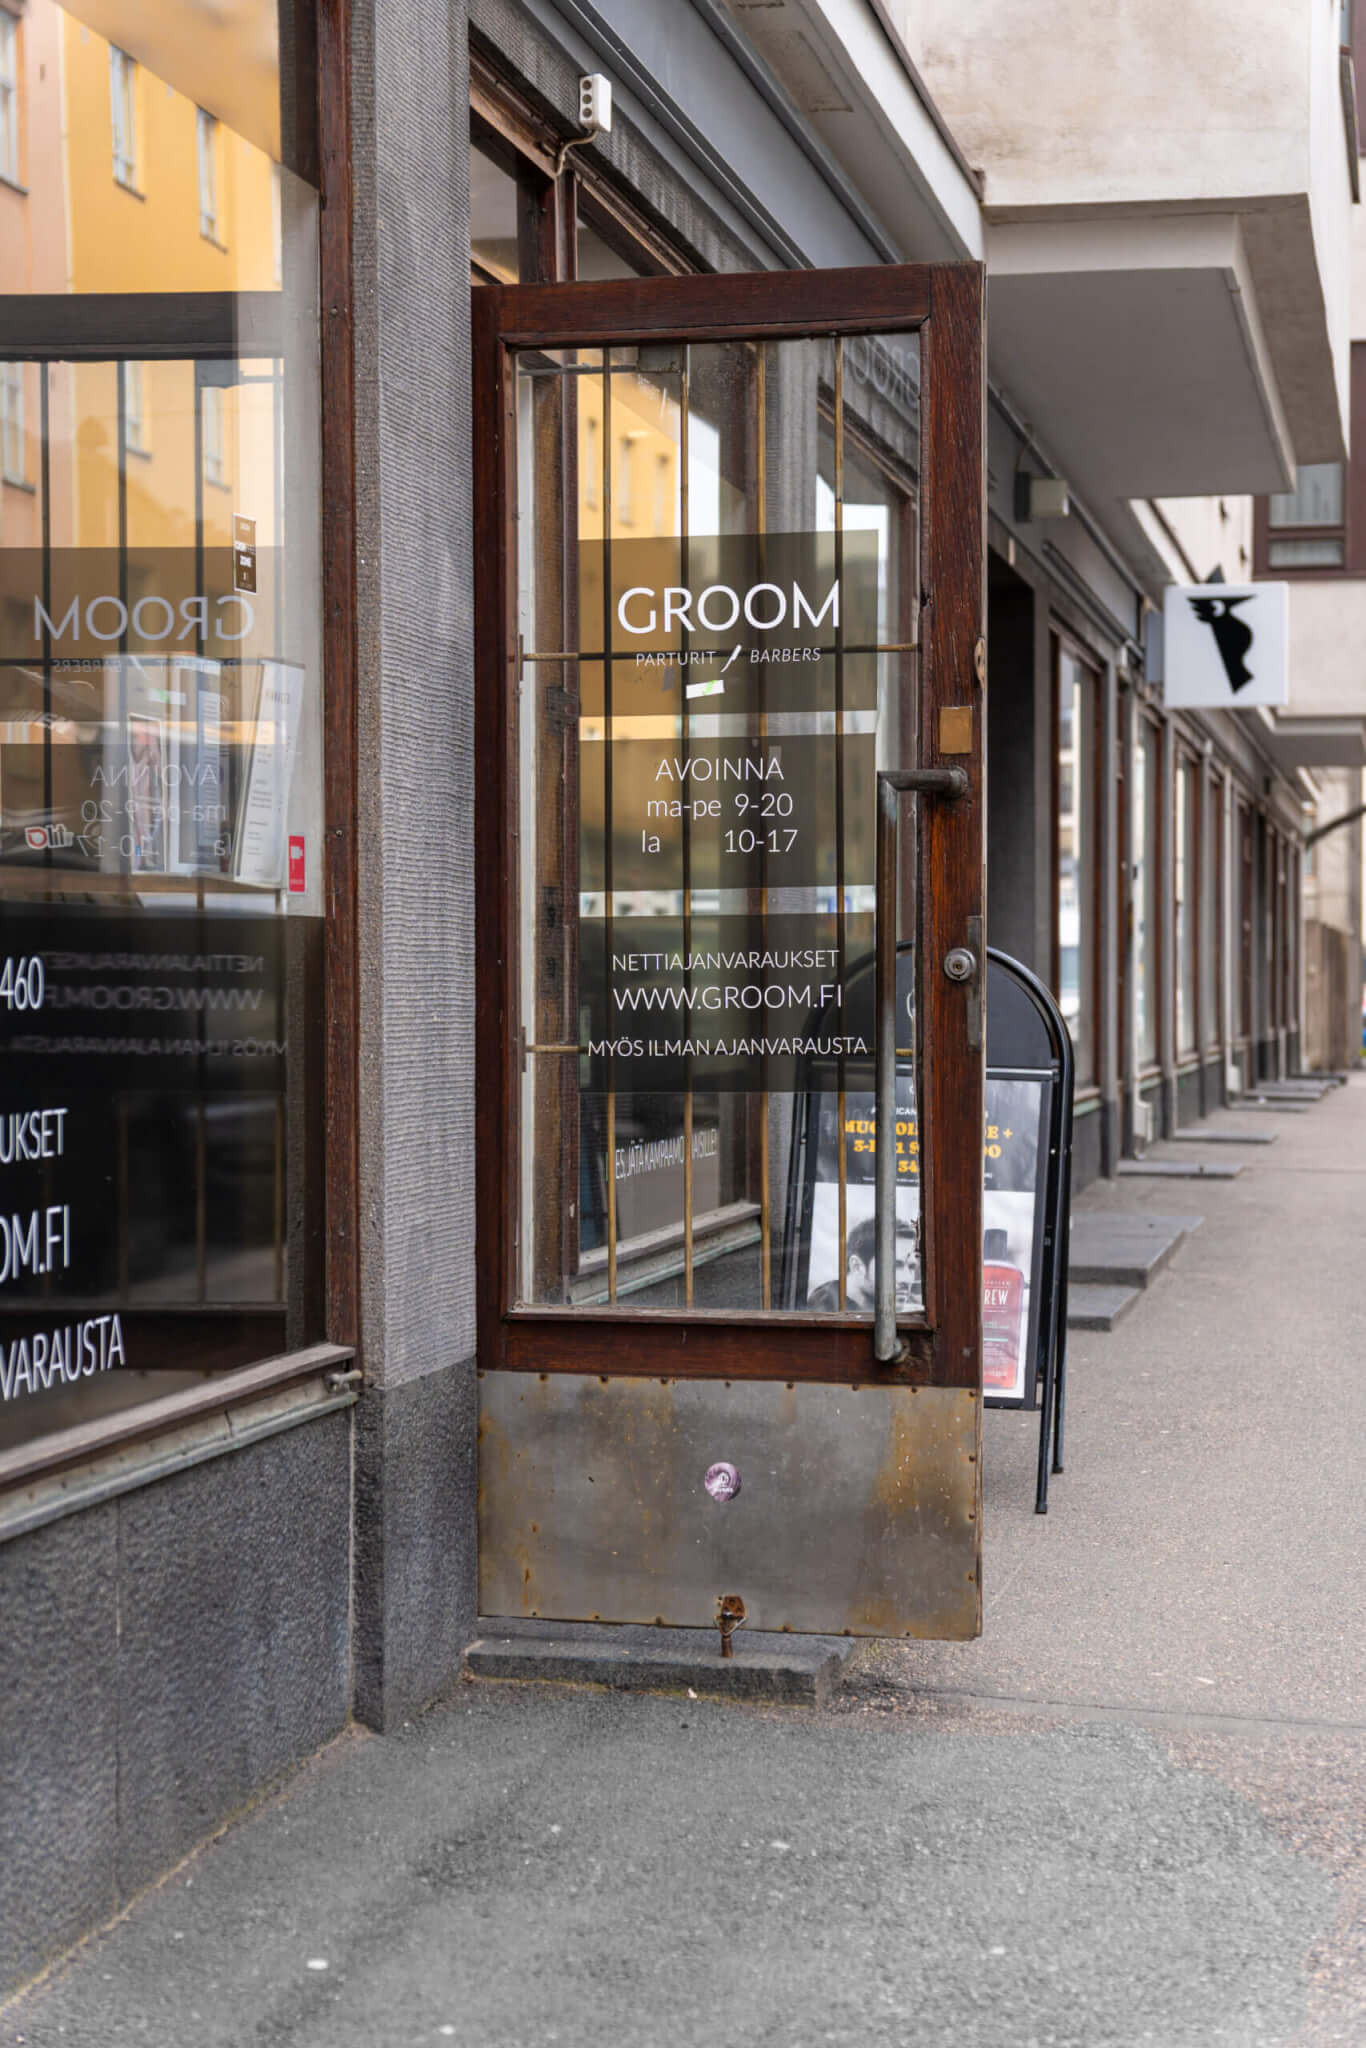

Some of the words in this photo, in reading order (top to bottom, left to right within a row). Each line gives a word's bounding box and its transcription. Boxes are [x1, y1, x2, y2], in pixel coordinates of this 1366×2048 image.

[617, 579, 840, 634] GROOM
[636, 651, 717, 667] PARTURIT
[750, 647, 821, 663] BARBERS
[655, 757, 784, 782] AVOINNA
[647, 798, 721, 821] ma-pe
[735, 792, 793, 817] 9-20
[641, 829, 661, 853] la
[724, 829, 799, 853] 10-17
[612, 950, 840, 971] NETTIAJANVARAUKSET
[0, 955, 45, 1011] 460
[613, 985, 842, 1011] WWW.GROOM.FI
[588, 1037, 644, 1057] MYÖS
[649, 1039, 710, 1057] ILMAN
[714, 1036, 868, 1056] AJANVARAUSTA
[0, 1107, 68, 1163] UKSET
[983, 1289, 1009, 1305] REW
[0, 1312, 126, 1402] VARAUSTA
